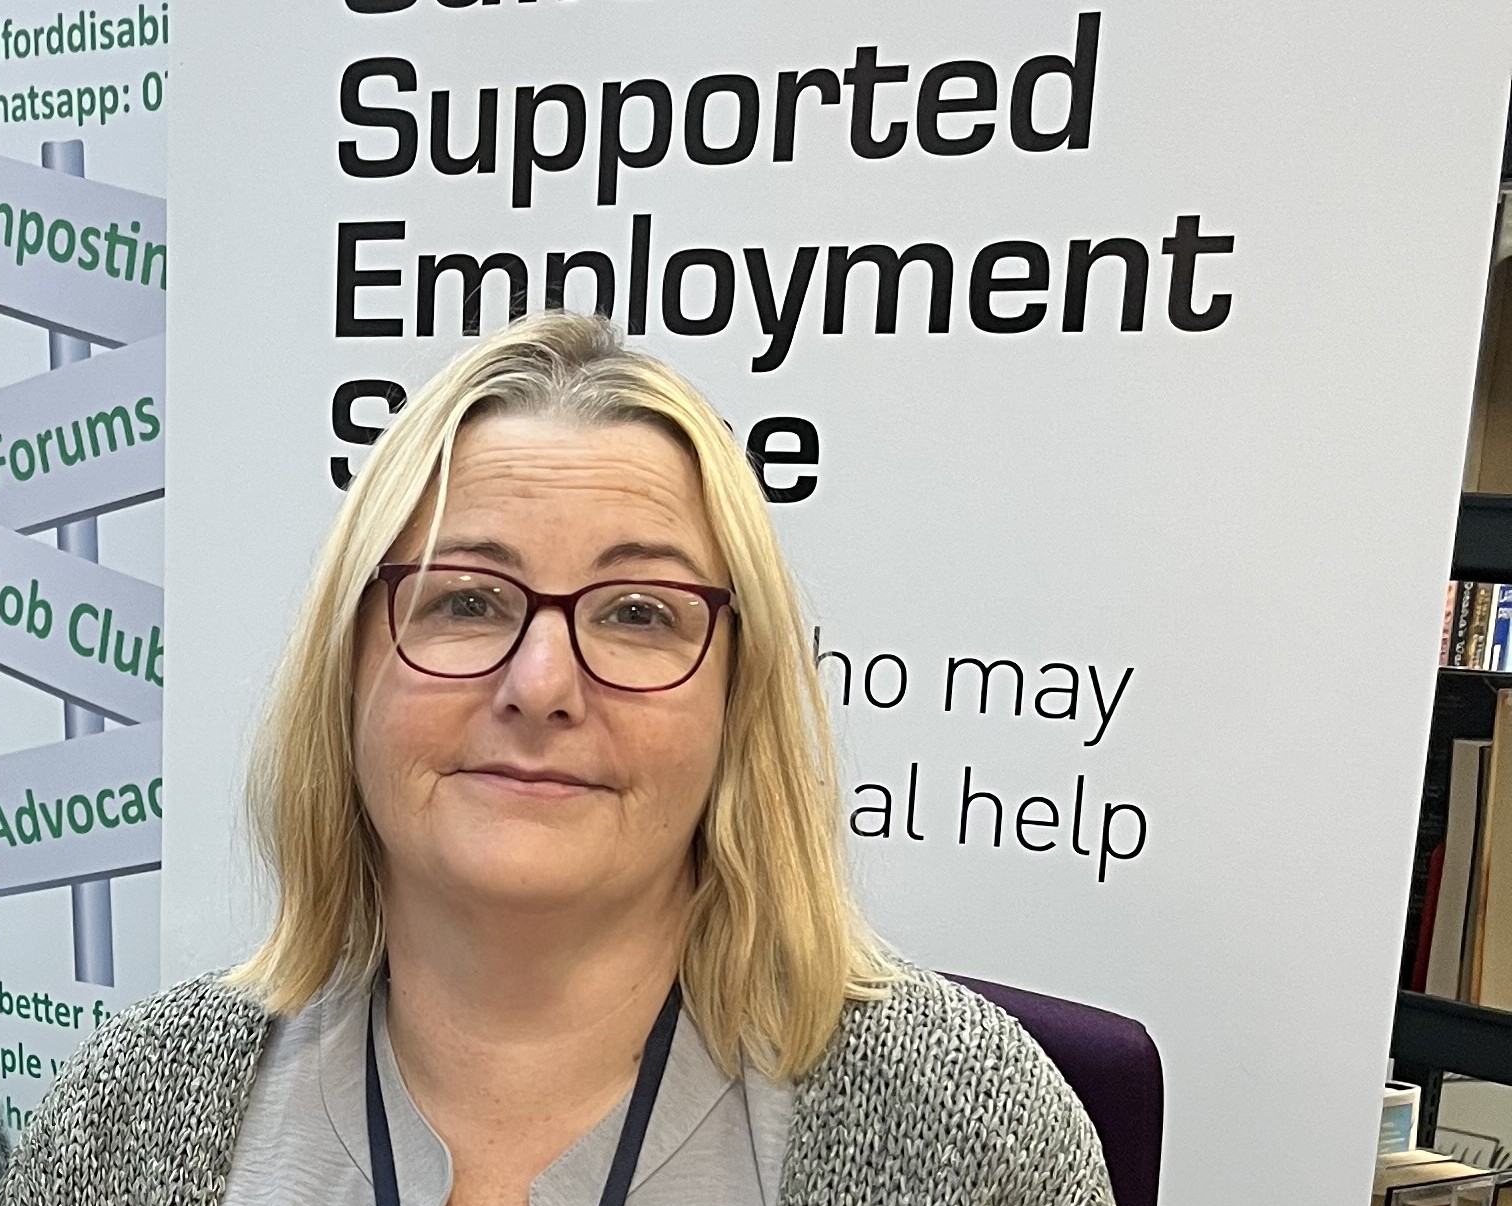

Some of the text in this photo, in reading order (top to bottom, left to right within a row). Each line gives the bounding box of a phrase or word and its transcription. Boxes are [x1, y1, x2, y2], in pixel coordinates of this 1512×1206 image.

[142, 71, 168, 112] 0
[339, 12, 1101, 208] Supported
[334, 214, 1235, 373] Employment
[69, 603, 164, 687] Club
[944, 657, 1134, 746] may
[959, 766, 1147, 882] help
